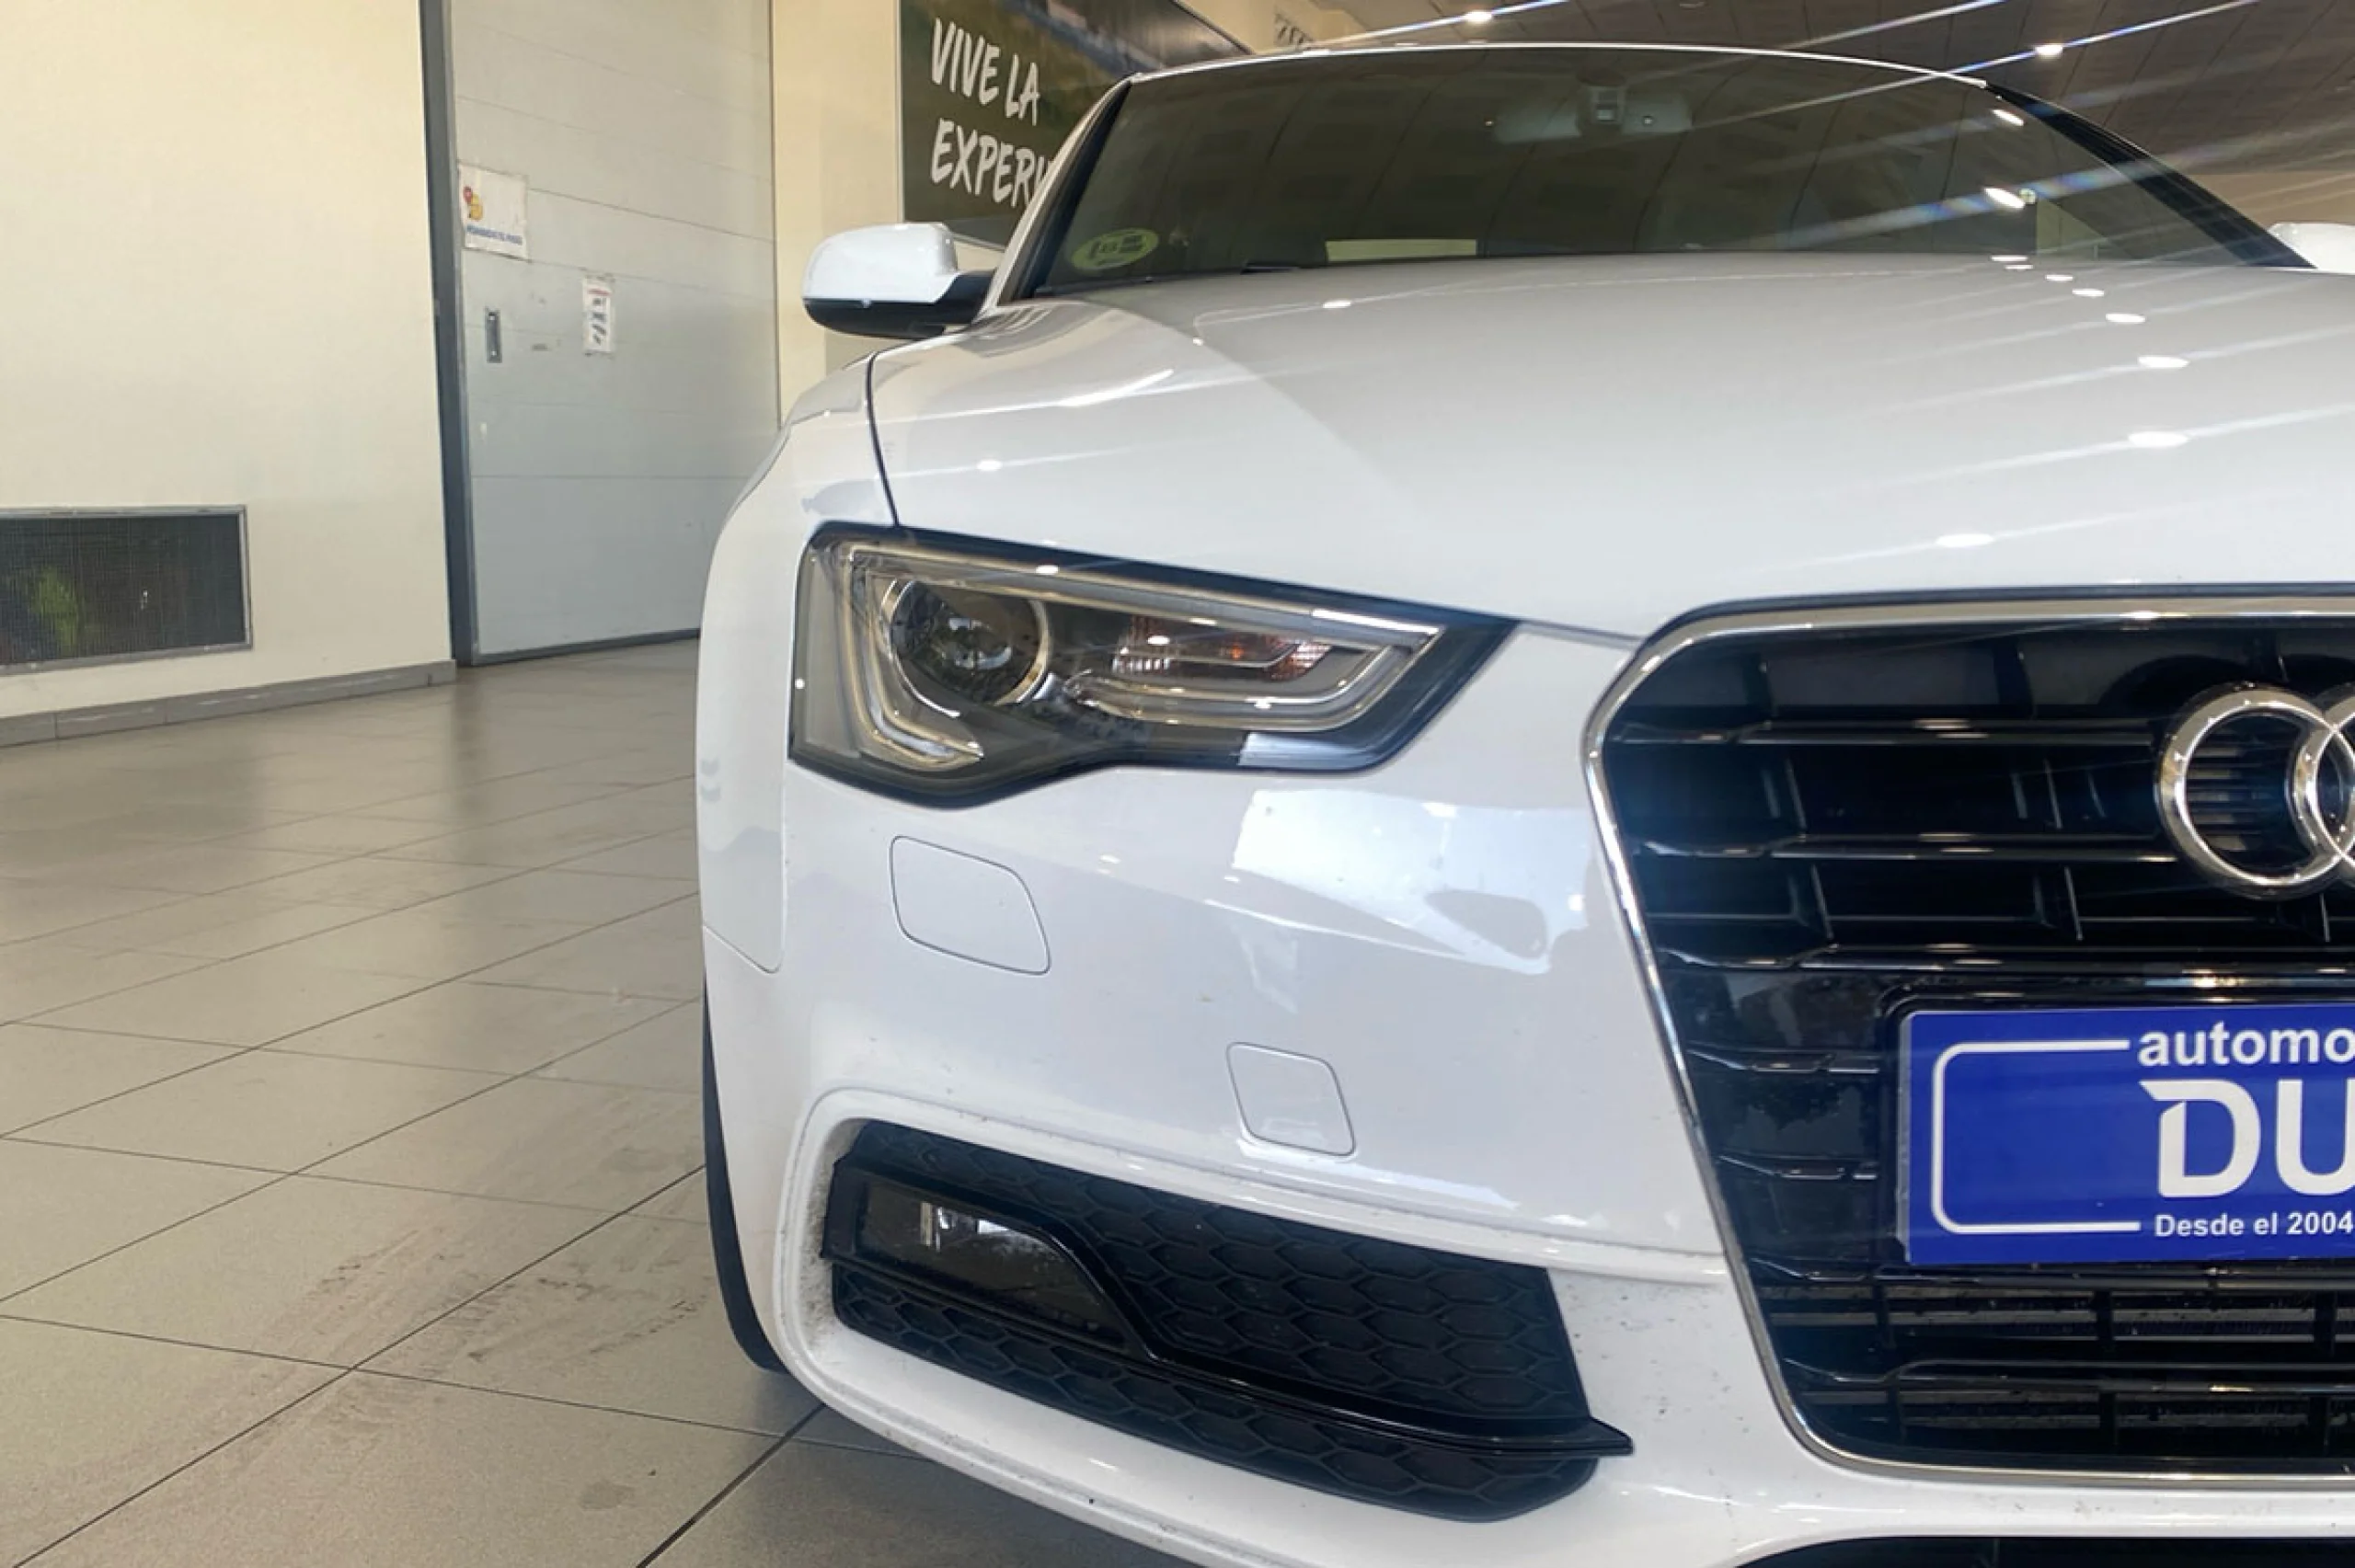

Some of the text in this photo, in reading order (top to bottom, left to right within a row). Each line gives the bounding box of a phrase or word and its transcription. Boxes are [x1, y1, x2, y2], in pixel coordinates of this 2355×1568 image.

[931, 17, 1040, 126] VIVE LA
[931, 118, 1055, 208] EXPERI
[2138, 1022, 2355, 1065] automo
[2139, 1079, 2355, 1197] DU
[2154, 1211, 2354, 1237] Desde el 2004
